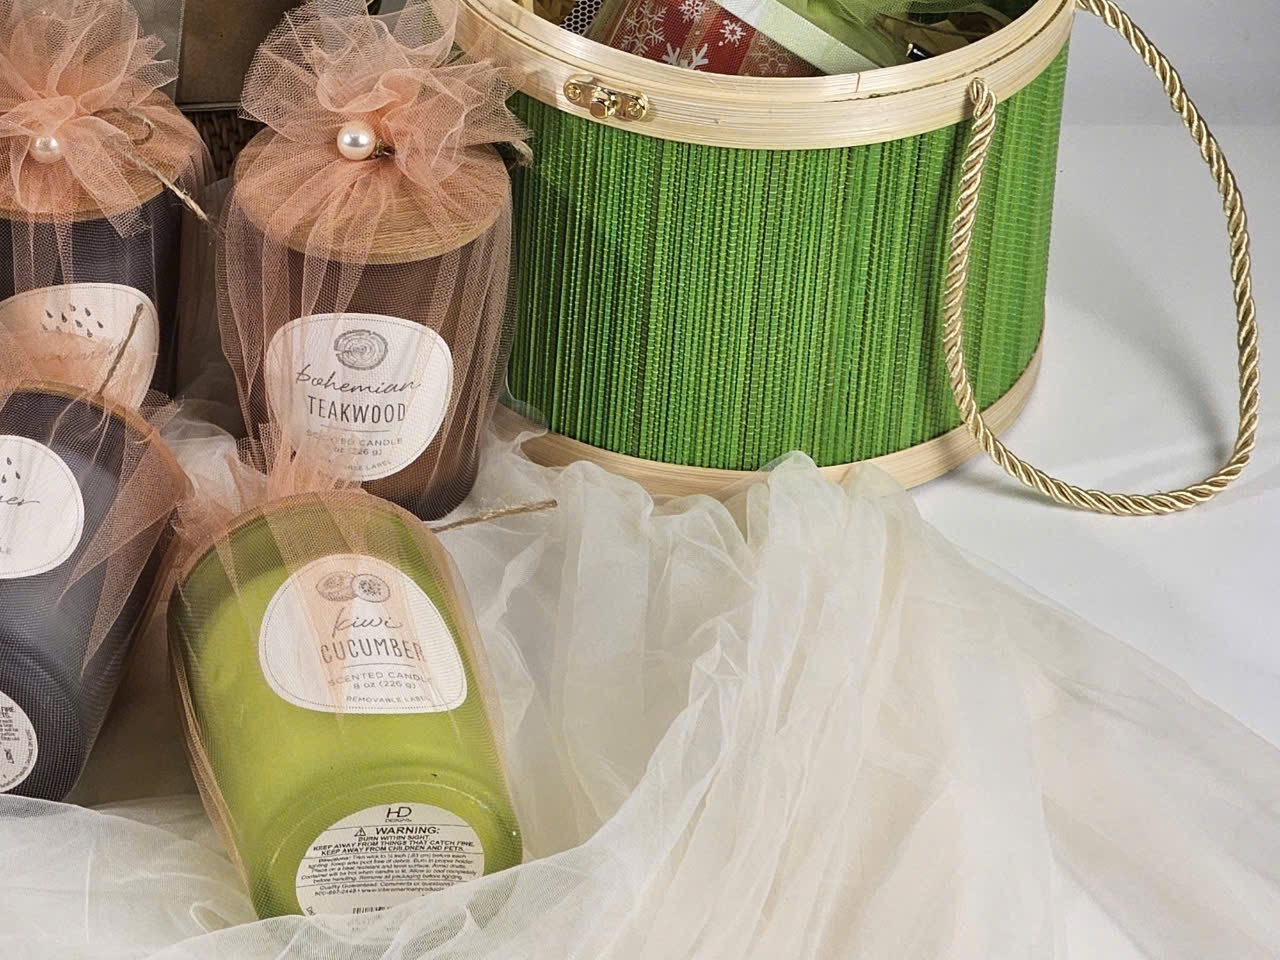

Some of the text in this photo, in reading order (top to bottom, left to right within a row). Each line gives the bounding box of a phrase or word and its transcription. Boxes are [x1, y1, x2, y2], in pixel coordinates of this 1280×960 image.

[296, 364, 421, 394] bohemian
[308, 395, 407, 424] TEAKWOOD
[360, 438, 402, 447] CANDLE
[332, 607, 403, 638] kiwi
[320, 638, 426, 664] CUCUMBER
[328, 671, 384, 687] SCENTED
[386, 806, 412, 818] HD
[375, 826, 440, 835] WARNING:
